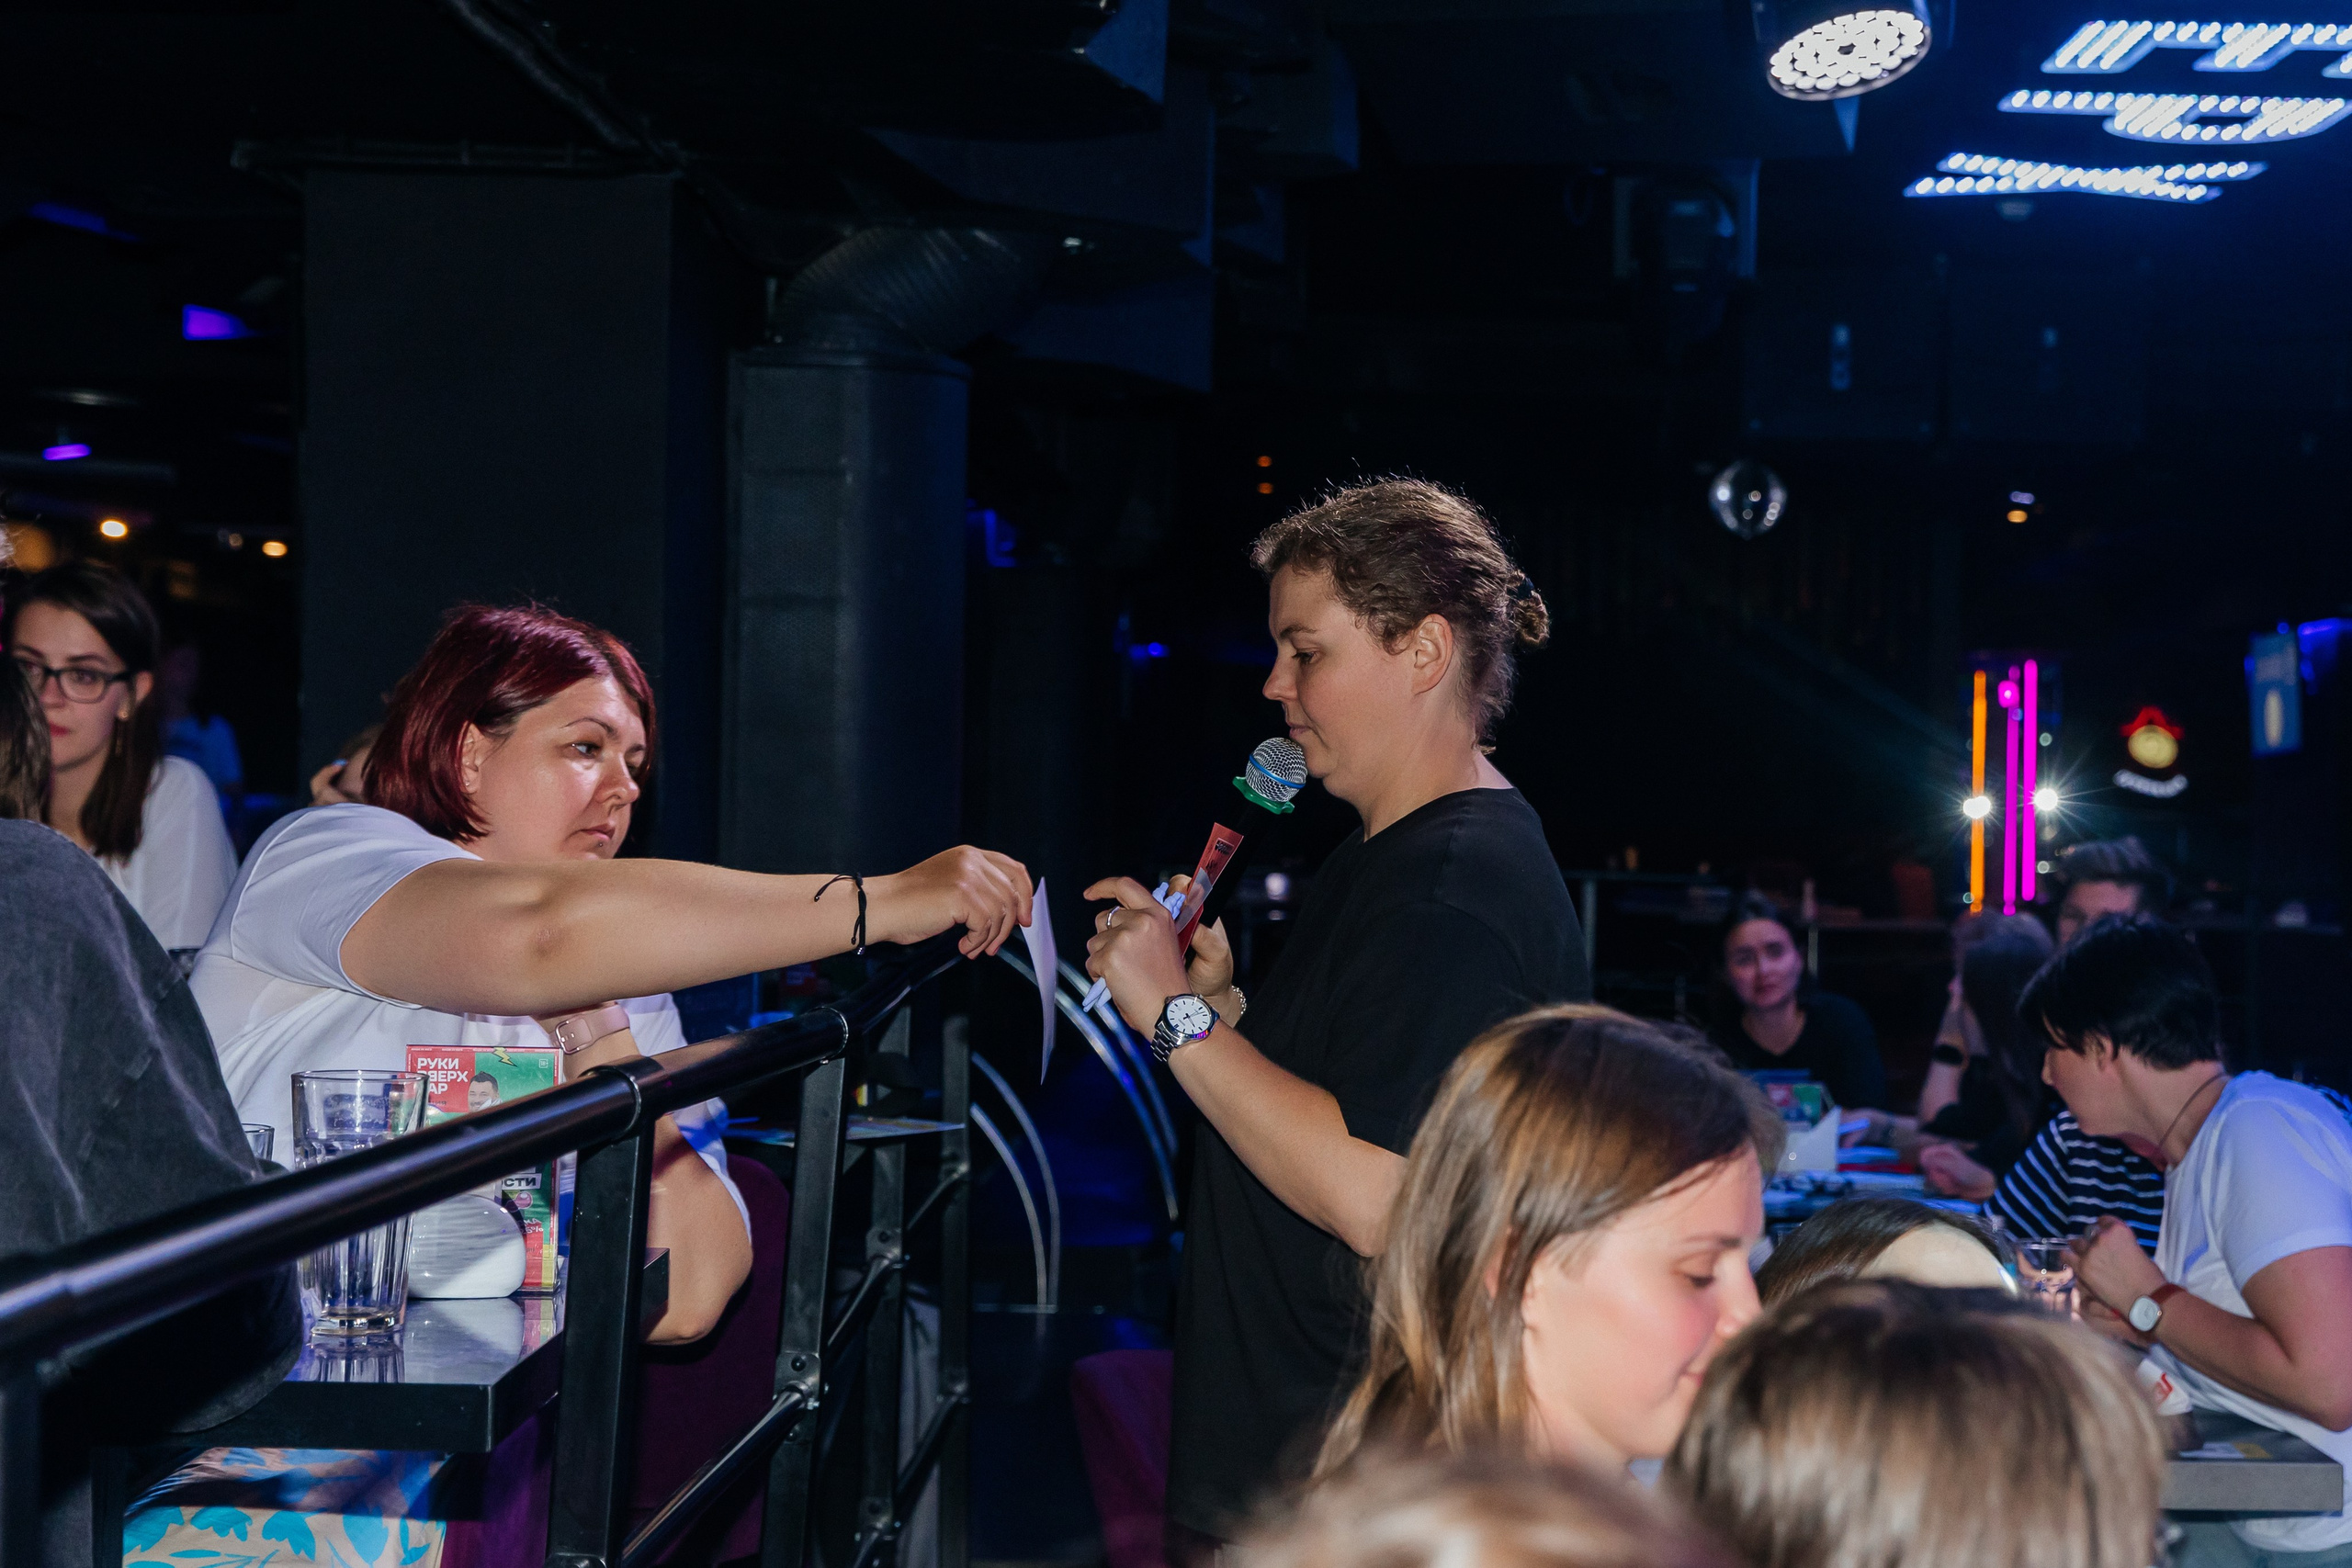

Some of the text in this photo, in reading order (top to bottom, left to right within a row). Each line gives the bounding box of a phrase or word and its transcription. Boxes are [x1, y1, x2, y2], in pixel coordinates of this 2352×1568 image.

[417, 1057, 459, 1070] РУКИ
[429, 1083, 448, 1095] АР
[502, 1177, 537, 1187] СТИ
